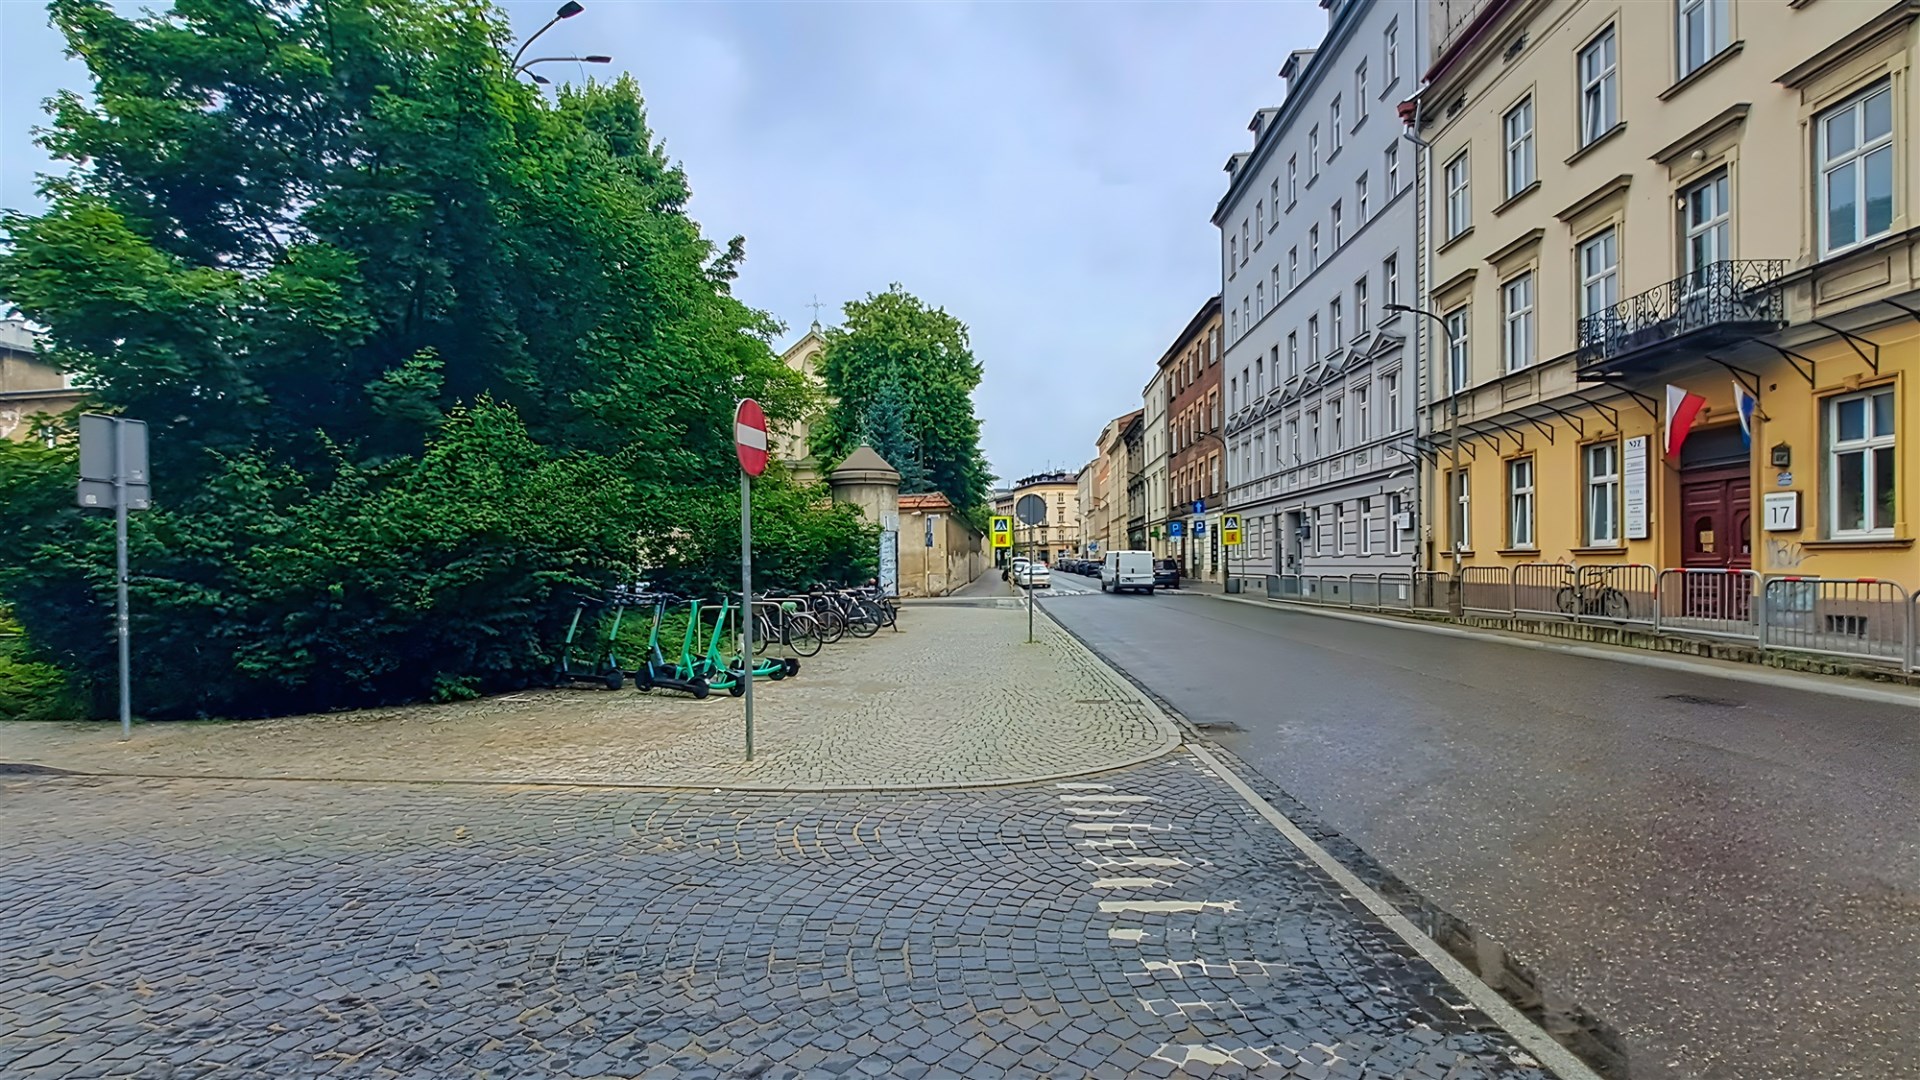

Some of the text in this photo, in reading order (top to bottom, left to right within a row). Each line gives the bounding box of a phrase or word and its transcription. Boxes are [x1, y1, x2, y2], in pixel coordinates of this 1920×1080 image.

[1772, 506, 1790, 524] 17
[1172, 524, 1179, 532] P
[1196, 522, 1204, 532] P
